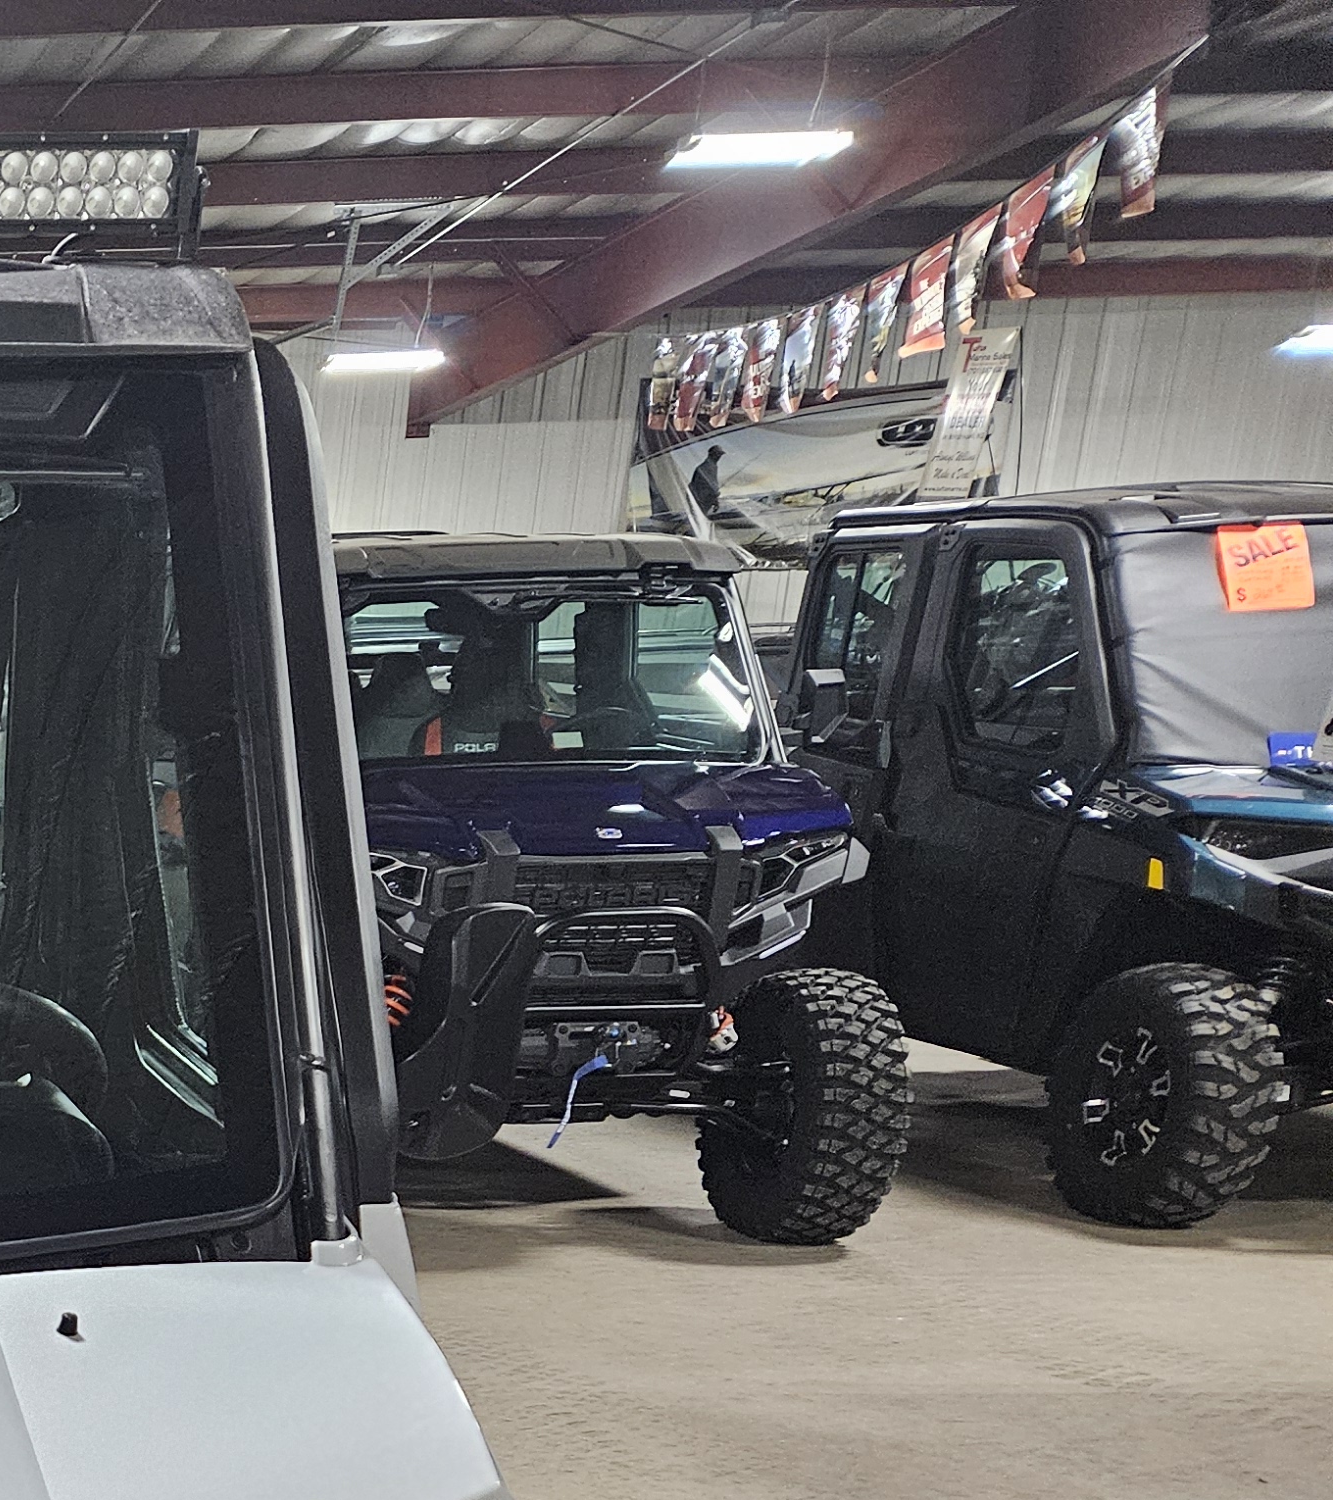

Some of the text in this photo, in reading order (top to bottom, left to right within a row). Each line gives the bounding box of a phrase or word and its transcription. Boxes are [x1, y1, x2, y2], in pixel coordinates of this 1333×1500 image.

[1227, 527, 1299, 567] SALE
[1236, 587, 1247, 603] $
[453, 742, 497, 754] POLA
